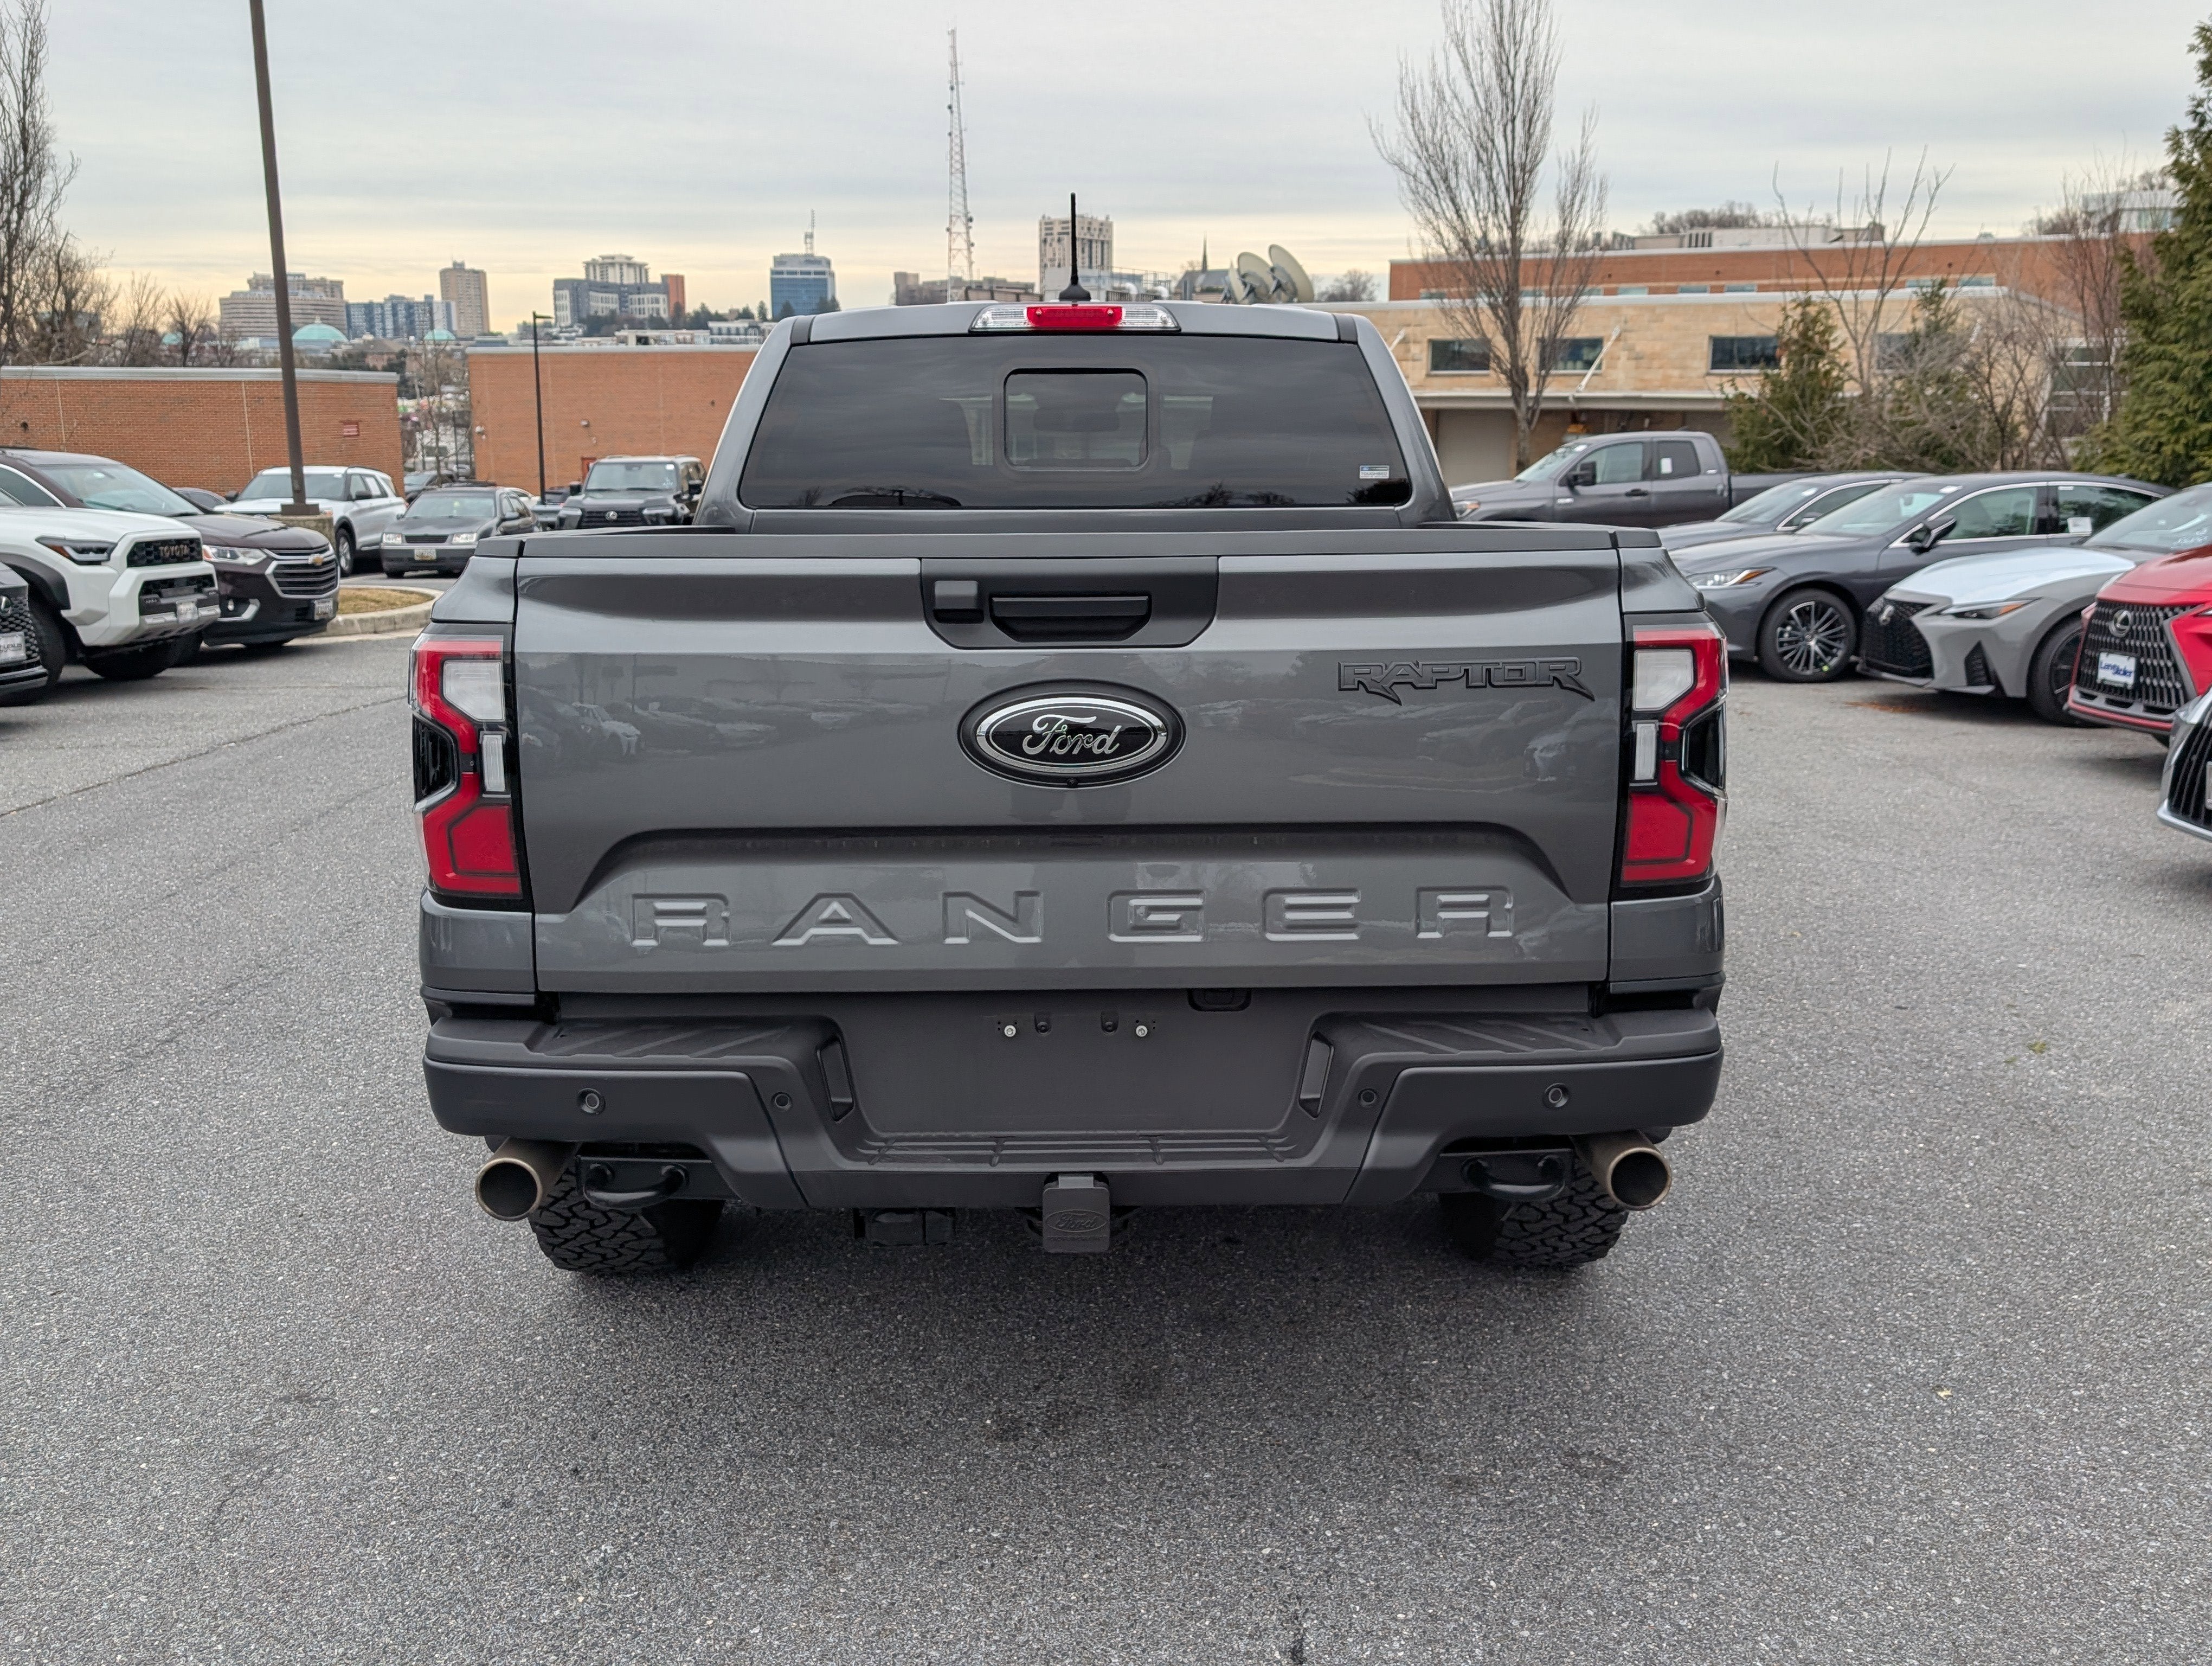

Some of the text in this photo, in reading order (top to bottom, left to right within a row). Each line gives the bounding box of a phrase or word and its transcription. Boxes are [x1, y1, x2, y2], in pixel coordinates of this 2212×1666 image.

[159, 544, 190, 558] TOYOTA
[1339, 657, 1596, 706] RAPTOR
[1022, 715, 1121, 755] Ford
[630, 885, 1514, 946] RANGER
[1056, 1212, 1099, 1229] Ford
